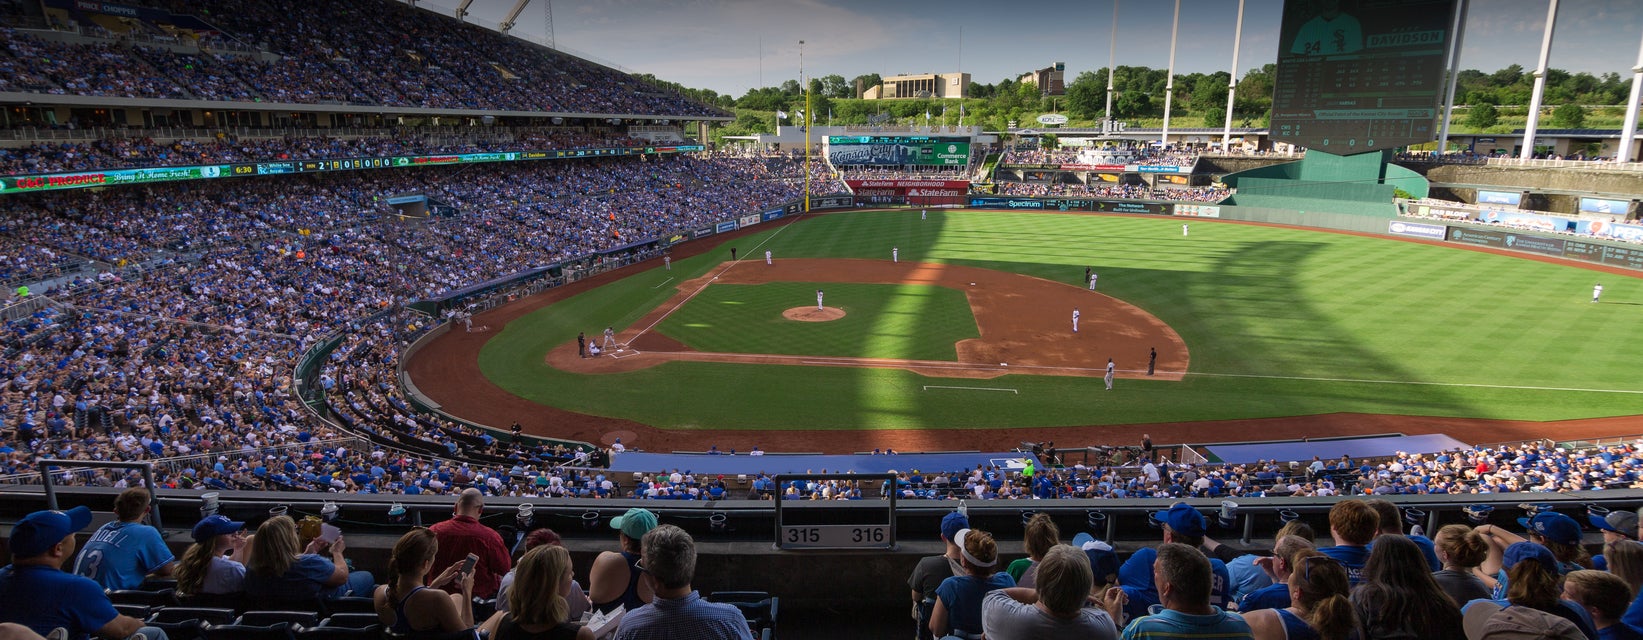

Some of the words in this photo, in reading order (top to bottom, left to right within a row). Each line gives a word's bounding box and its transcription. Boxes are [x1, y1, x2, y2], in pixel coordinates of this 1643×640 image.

[77, 1, 99, 10] PRICE
[103, 5, 137, 15] CHOPPER
[1371, 31, 1440, 46] DAVIDSON
[831, 150, 870, 164] Kansas
[870, 144, 892, 159] City
[235, 166, 253, 174] 6:30
[318, 162, 325, 170] 2
[48, 174, 106, 187] PRODUCE
[114, 173, 136, 181] Bring
[146, 171, 168, 179] Home
[1008, 200, 1041, 208] Spectrum
[788, 528, 820, 543] 315
[852, 527, 884, 543] 316
[73, 549, 104, 579] 13
